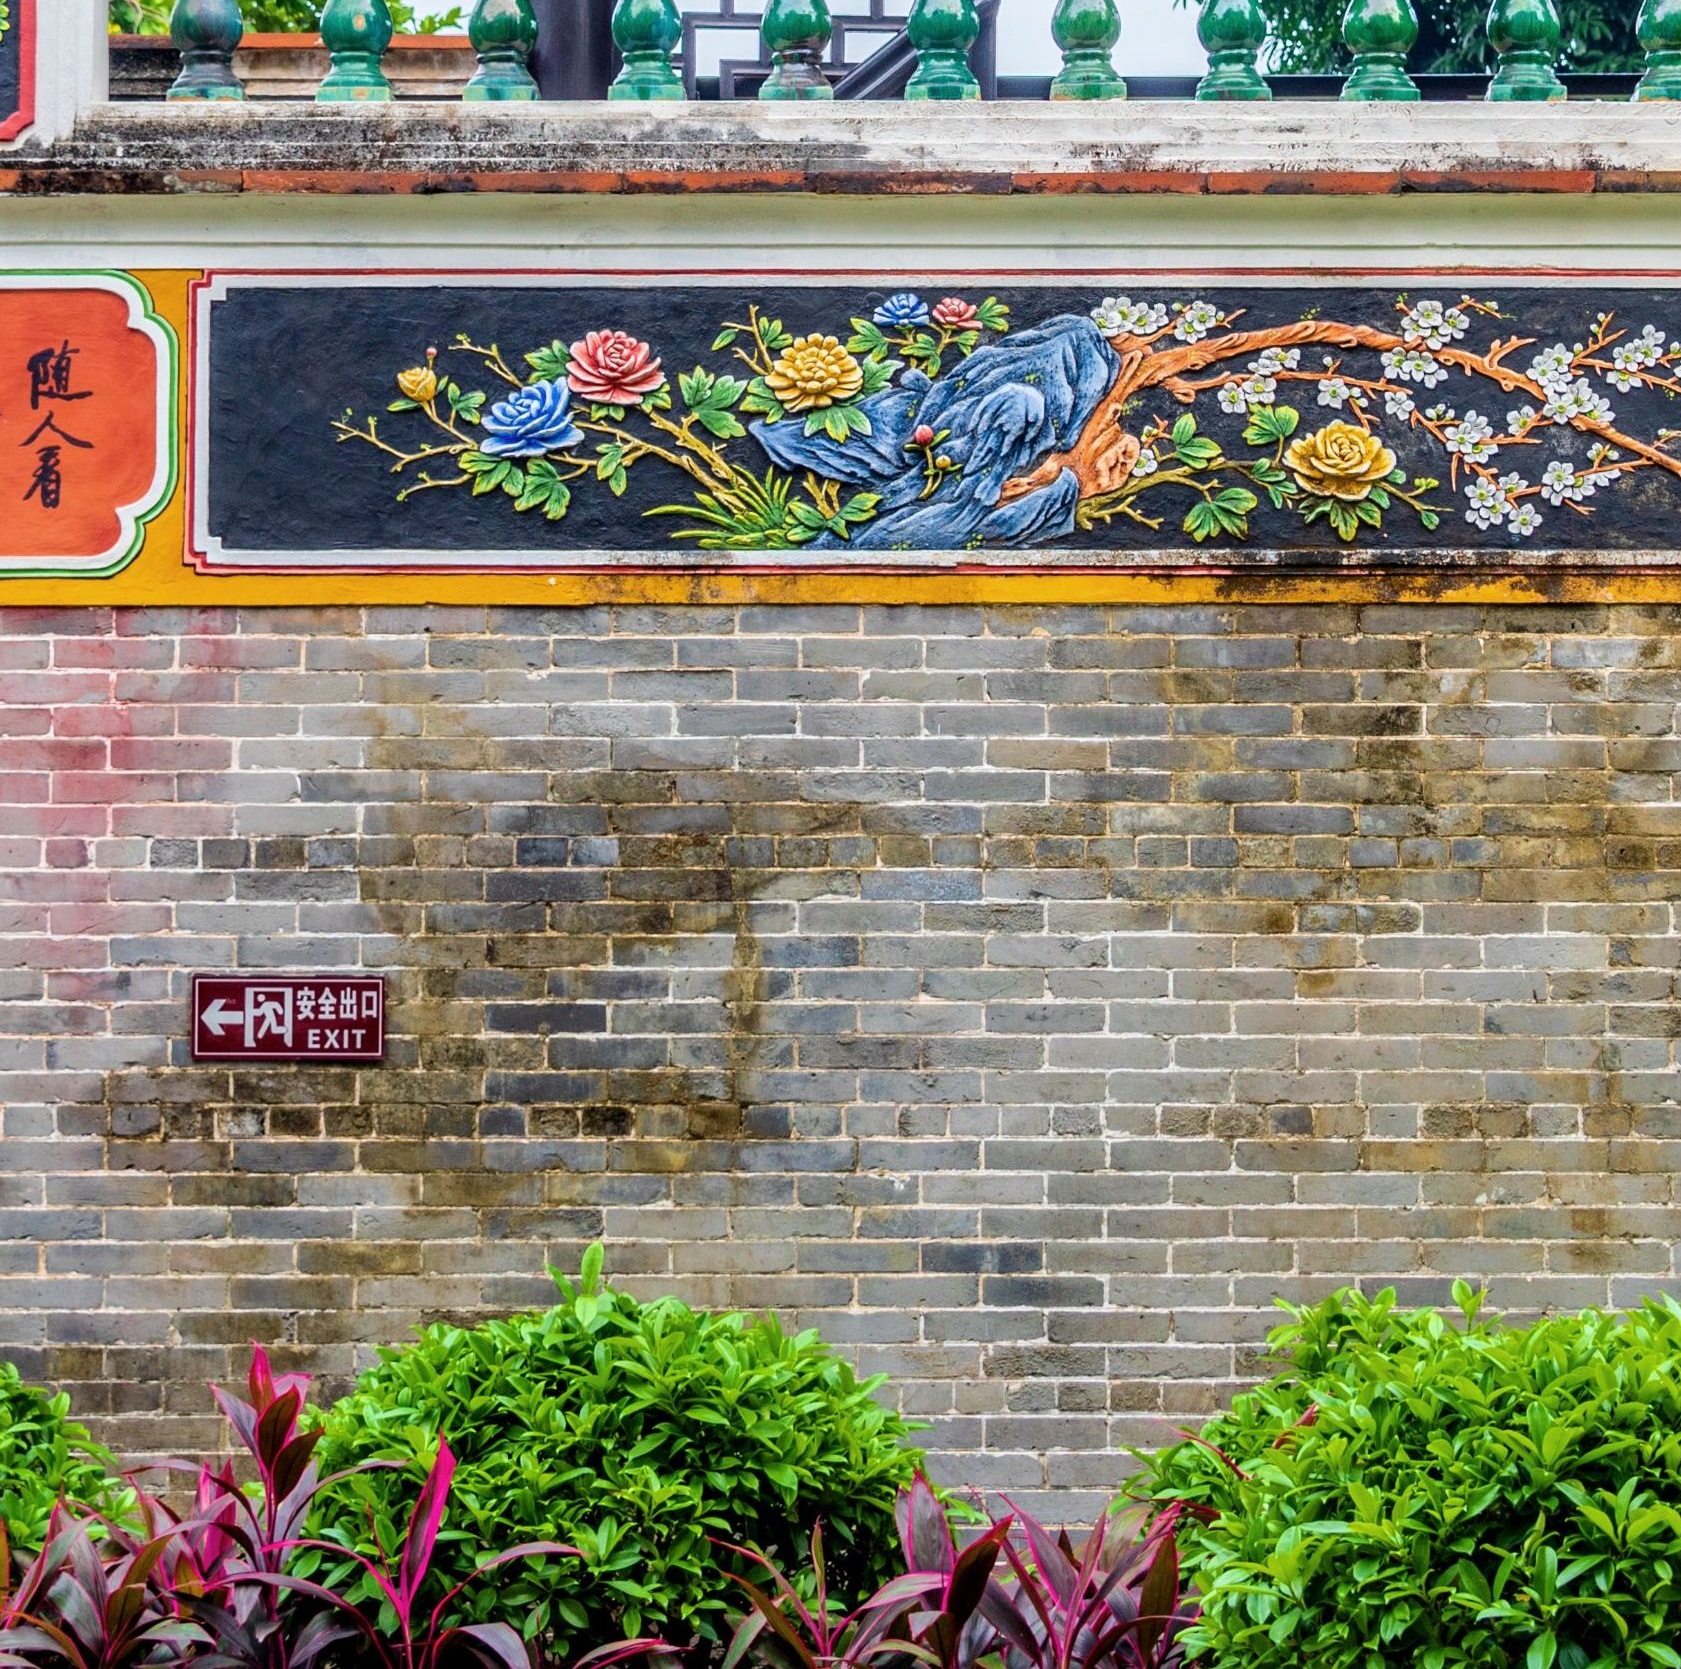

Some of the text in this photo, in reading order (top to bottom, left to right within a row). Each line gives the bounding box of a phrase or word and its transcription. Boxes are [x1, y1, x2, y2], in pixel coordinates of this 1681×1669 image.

[296, 986, 378, 1020] 安全出口
[307, 1028, 367, 1049] EXIT
